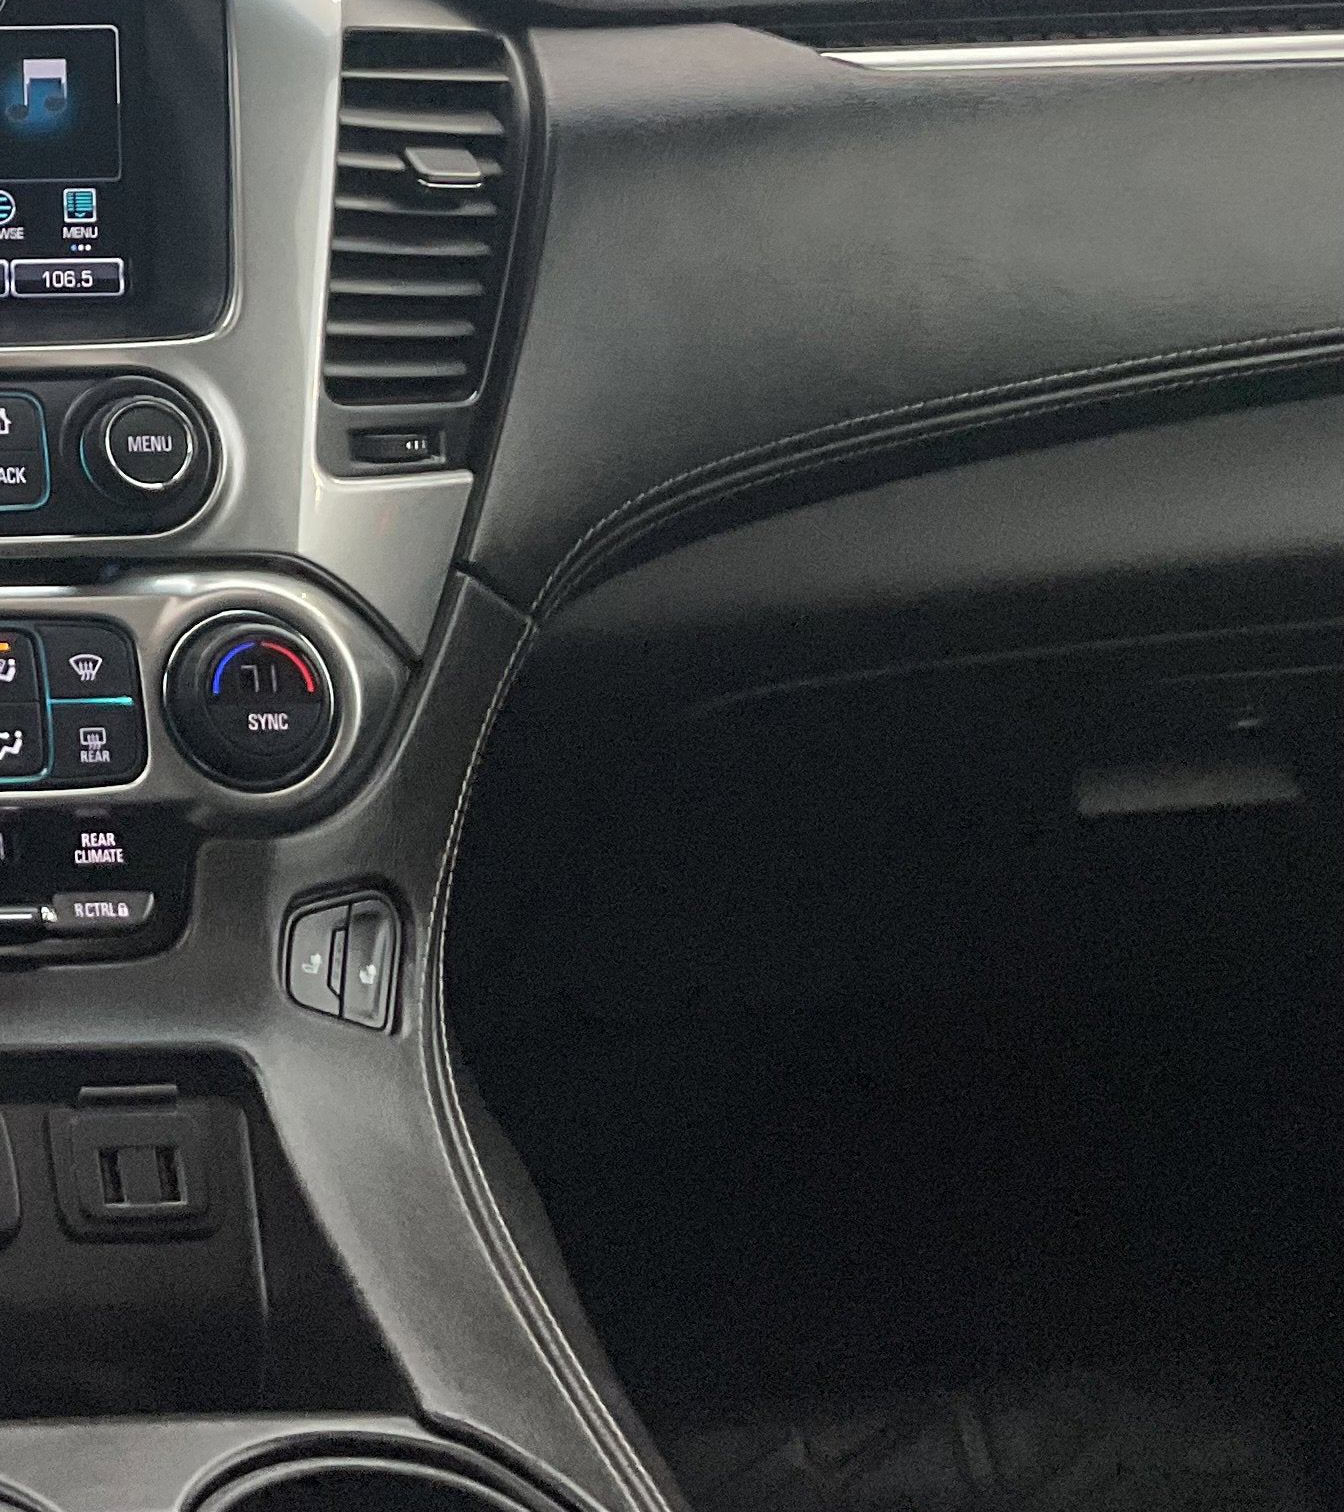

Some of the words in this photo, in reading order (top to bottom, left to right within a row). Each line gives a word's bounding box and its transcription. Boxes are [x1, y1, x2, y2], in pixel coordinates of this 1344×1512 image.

[62, 226, 99, 239] MENU
[42, 270, 94, 288] 106.5
[127, 436, 173, 453] MENU
[241, 665, 278, 694] 71
[248, 713, 289, 731] SYNC
[80, 750, 110, 763] REAR
[81, 833, 116, 847] REAR
[74, 849, 124, 864] CLIMATE
